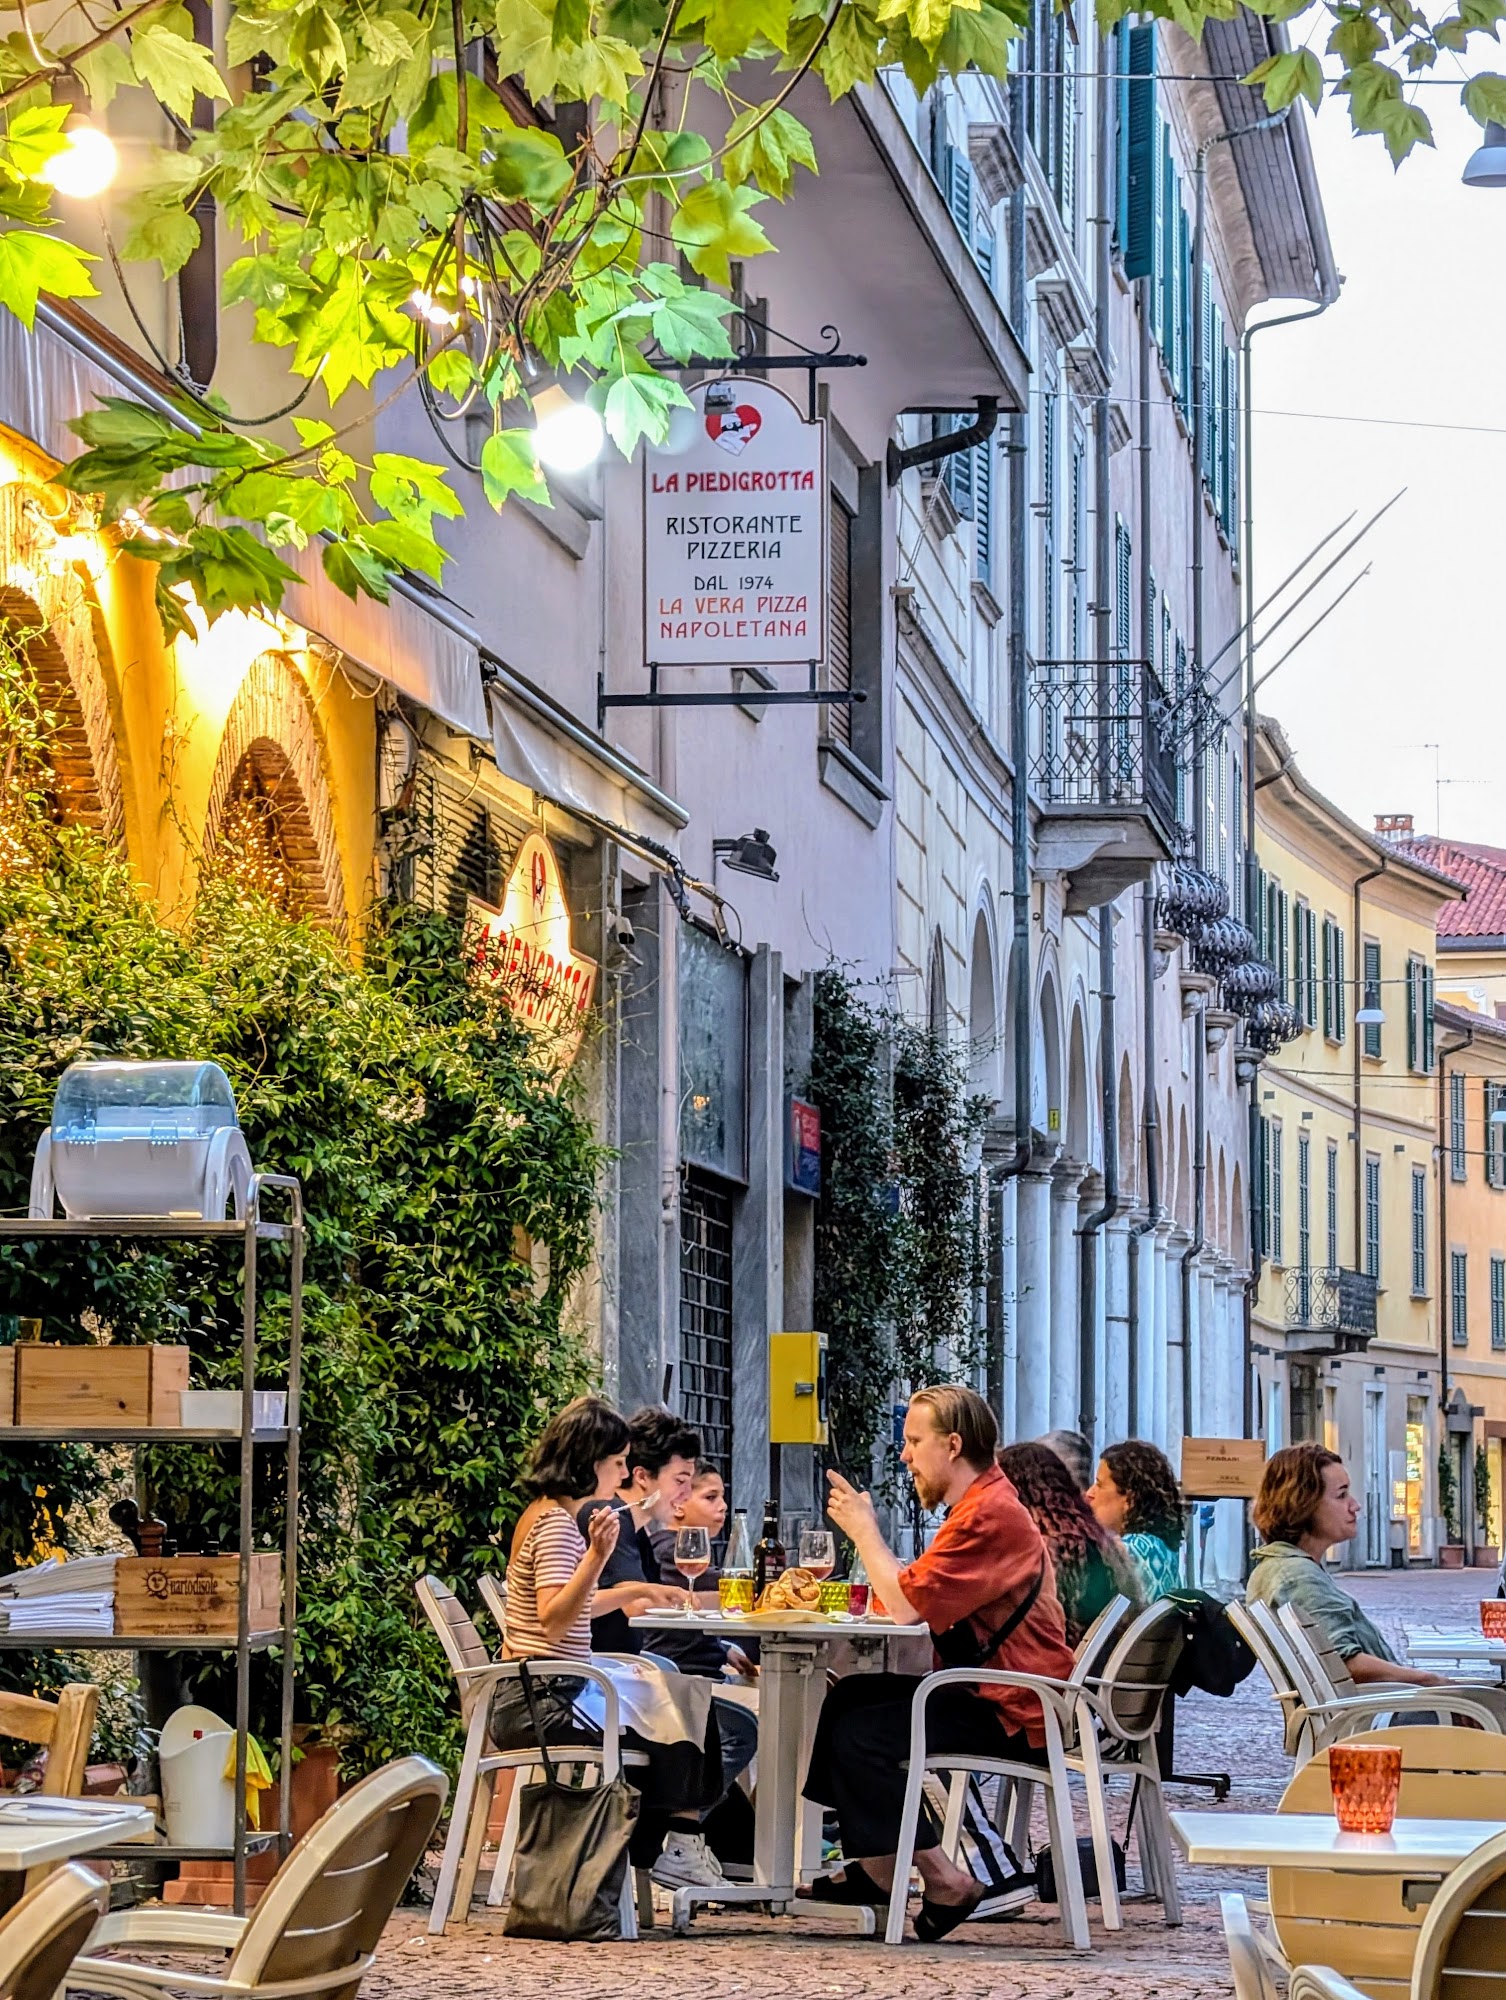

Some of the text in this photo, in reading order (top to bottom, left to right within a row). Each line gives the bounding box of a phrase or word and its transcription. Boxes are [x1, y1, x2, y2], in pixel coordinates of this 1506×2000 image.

[652, 470, 815, 493] LA PIEDIGROTTA
[666, 515, 803, 535] RISTORANTE
[687, 541, 781, 560] PIZZERIA
[694, 575, 774, 591] DAL 1974
[659, 595, 807, 615] LA VERA PIZZA
[660, 620, 807, 639] NAPOLETANA
